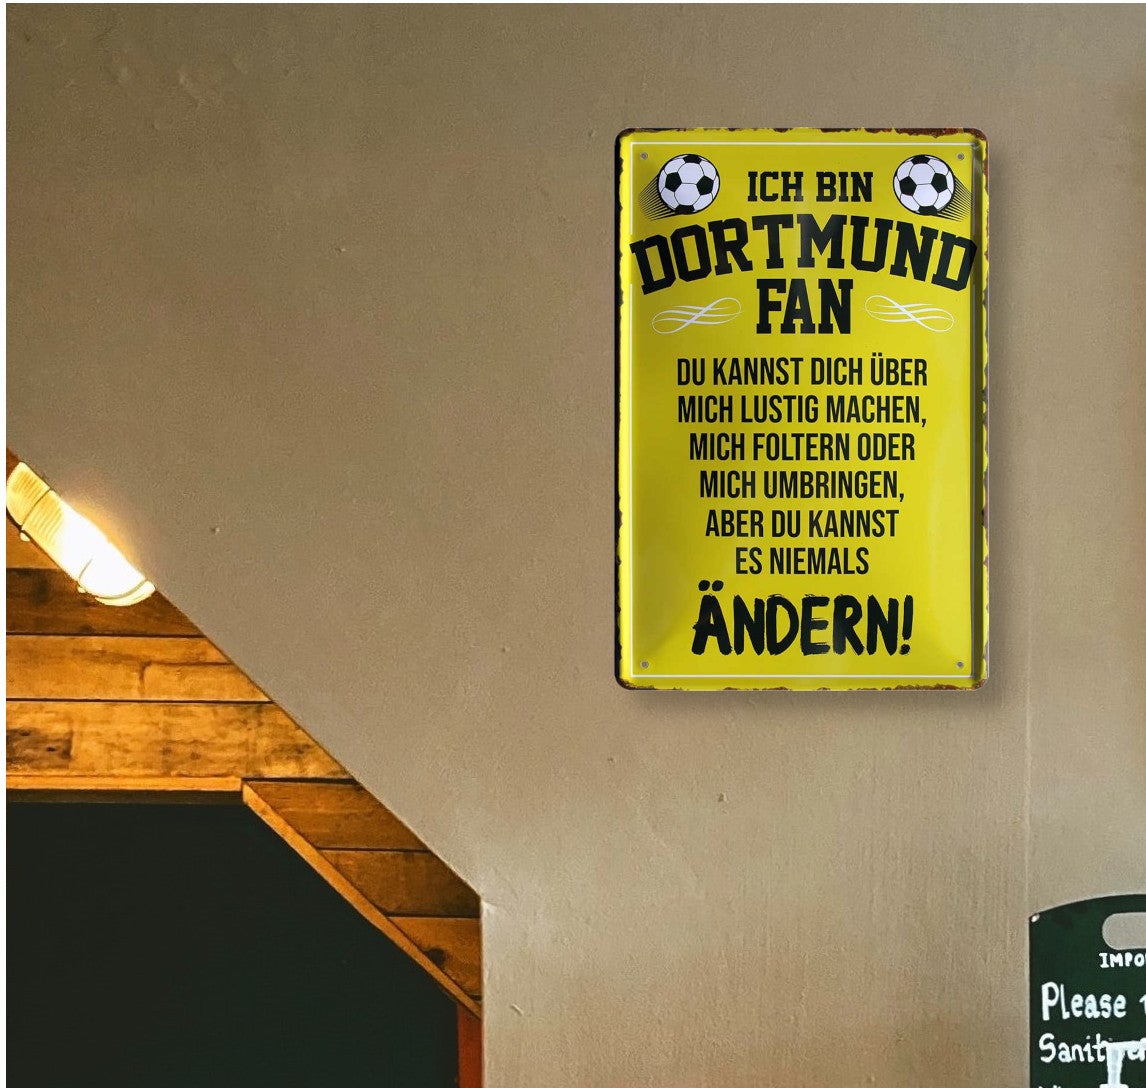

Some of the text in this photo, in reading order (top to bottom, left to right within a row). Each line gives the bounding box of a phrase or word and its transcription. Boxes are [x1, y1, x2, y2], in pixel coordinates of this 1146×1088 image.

[748, 171, 873, 202] ICH BIN
[630, 213, 978, 296] DORTMUND
[756, 278, 853, 334] FAN
[677, 352, 928, 386] DU KANNST DICH ÜBER
[678, 395, 927, 427] MICH LUSTIG MACHEN,
[689, 433, 915, 460] MICH FOLTERN ODER
[700, 470, 905, 502] MICH UMBRINGEN,
[705, 510, 899, 537] ABER DU KANNST
[735, 547, 869, 574] ES NIEMALS
[691, 580, 914, 655] ÄNDERN!
[1041, 982, 1127, 1021] Please
[1039, 1033, 1146, 1063] Saniter
